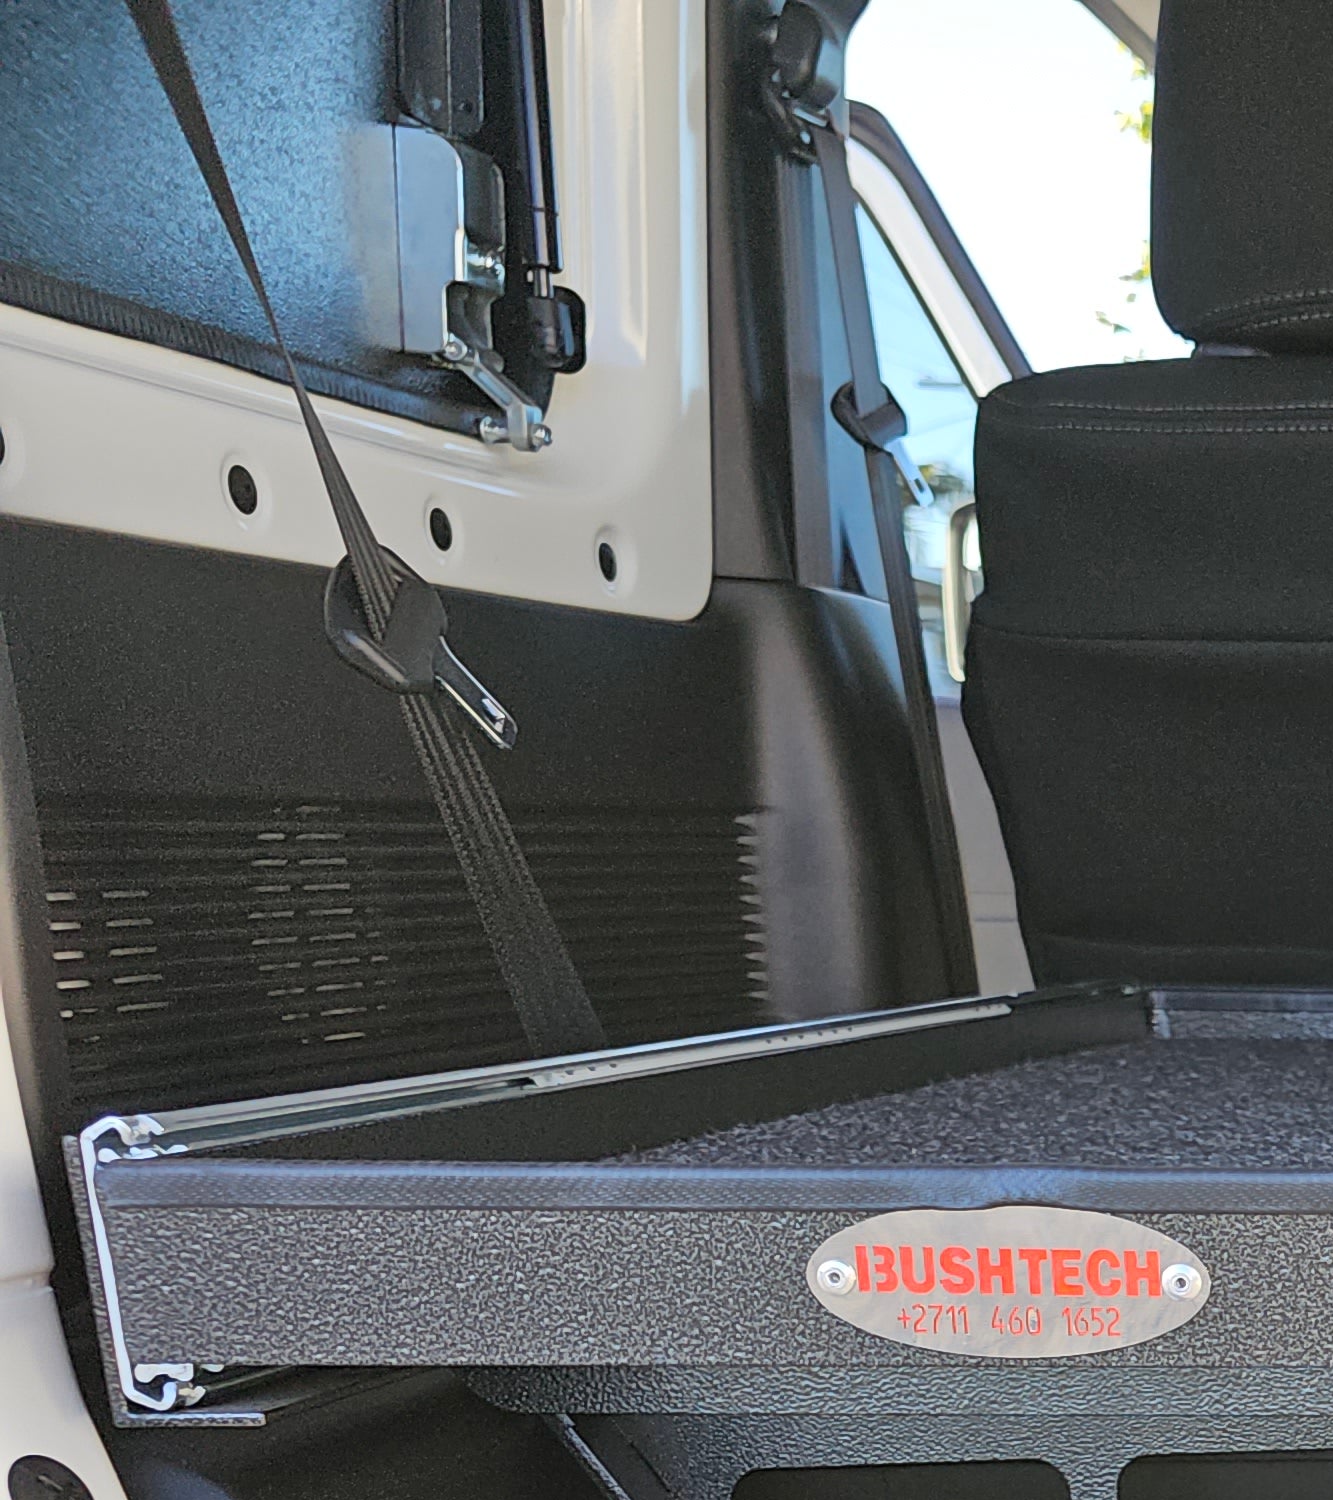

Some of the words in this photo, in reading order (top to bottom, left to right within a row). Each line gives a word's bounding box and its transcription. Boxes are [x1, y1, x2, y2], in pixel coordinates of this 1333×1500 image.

[854, 1244, 1162, 1298] BUSHTECH
[897, 1303, 970, 1335] +2711
[991, 1305, 1042, 1336] 460
[1061, 1306, 1121, 1337] 1652
